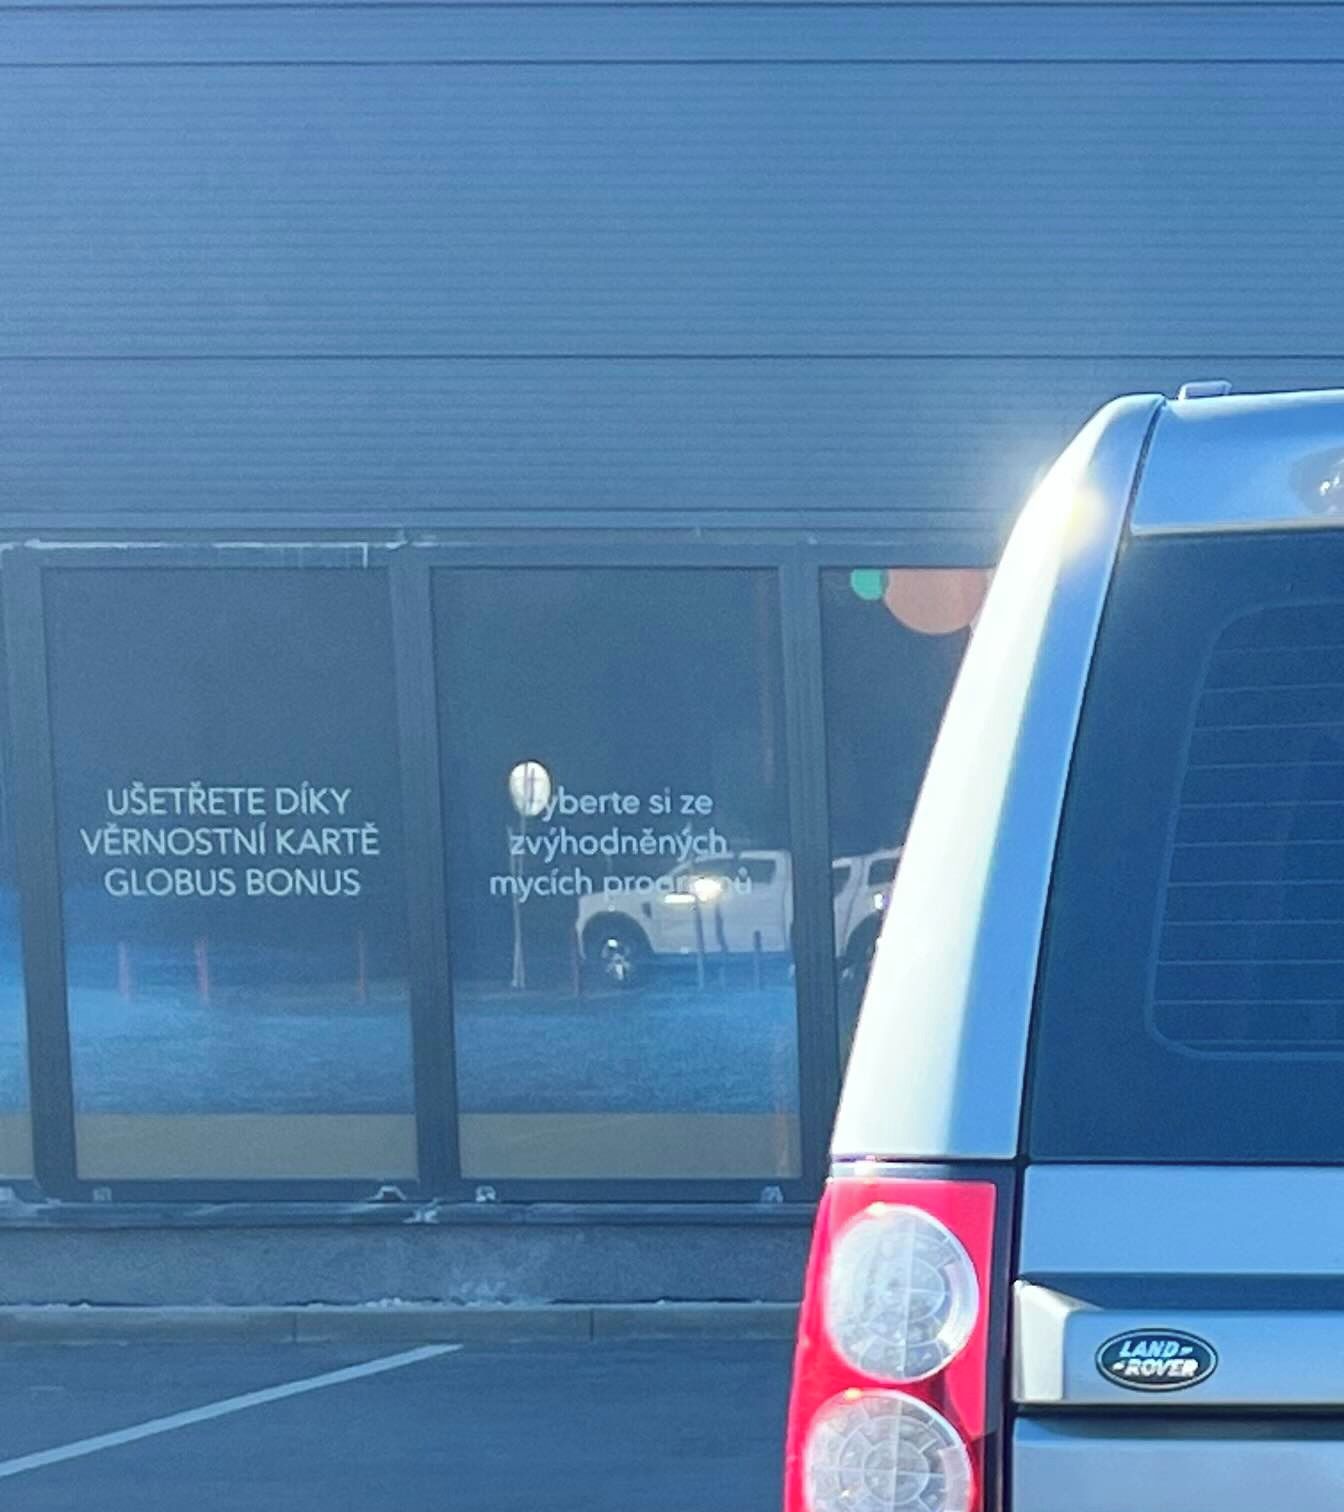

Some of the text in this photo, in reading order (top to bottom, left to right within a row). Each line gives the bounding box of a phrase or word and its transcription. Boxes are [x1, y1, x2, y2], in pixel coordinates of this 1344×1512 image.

[106, 780, 352, 816] UŠETŘETE DÍKY
[524, 785, 714, 822] yberte si ze
[79, 821, 381, 856] VĚRNOSTNÍ KARTĚ
[509, 823, 728, 864] zvýhodněných
[104, 867, 362, 897] GLOBUS BONUS
[489, 867, 752, 903] mycích progů
